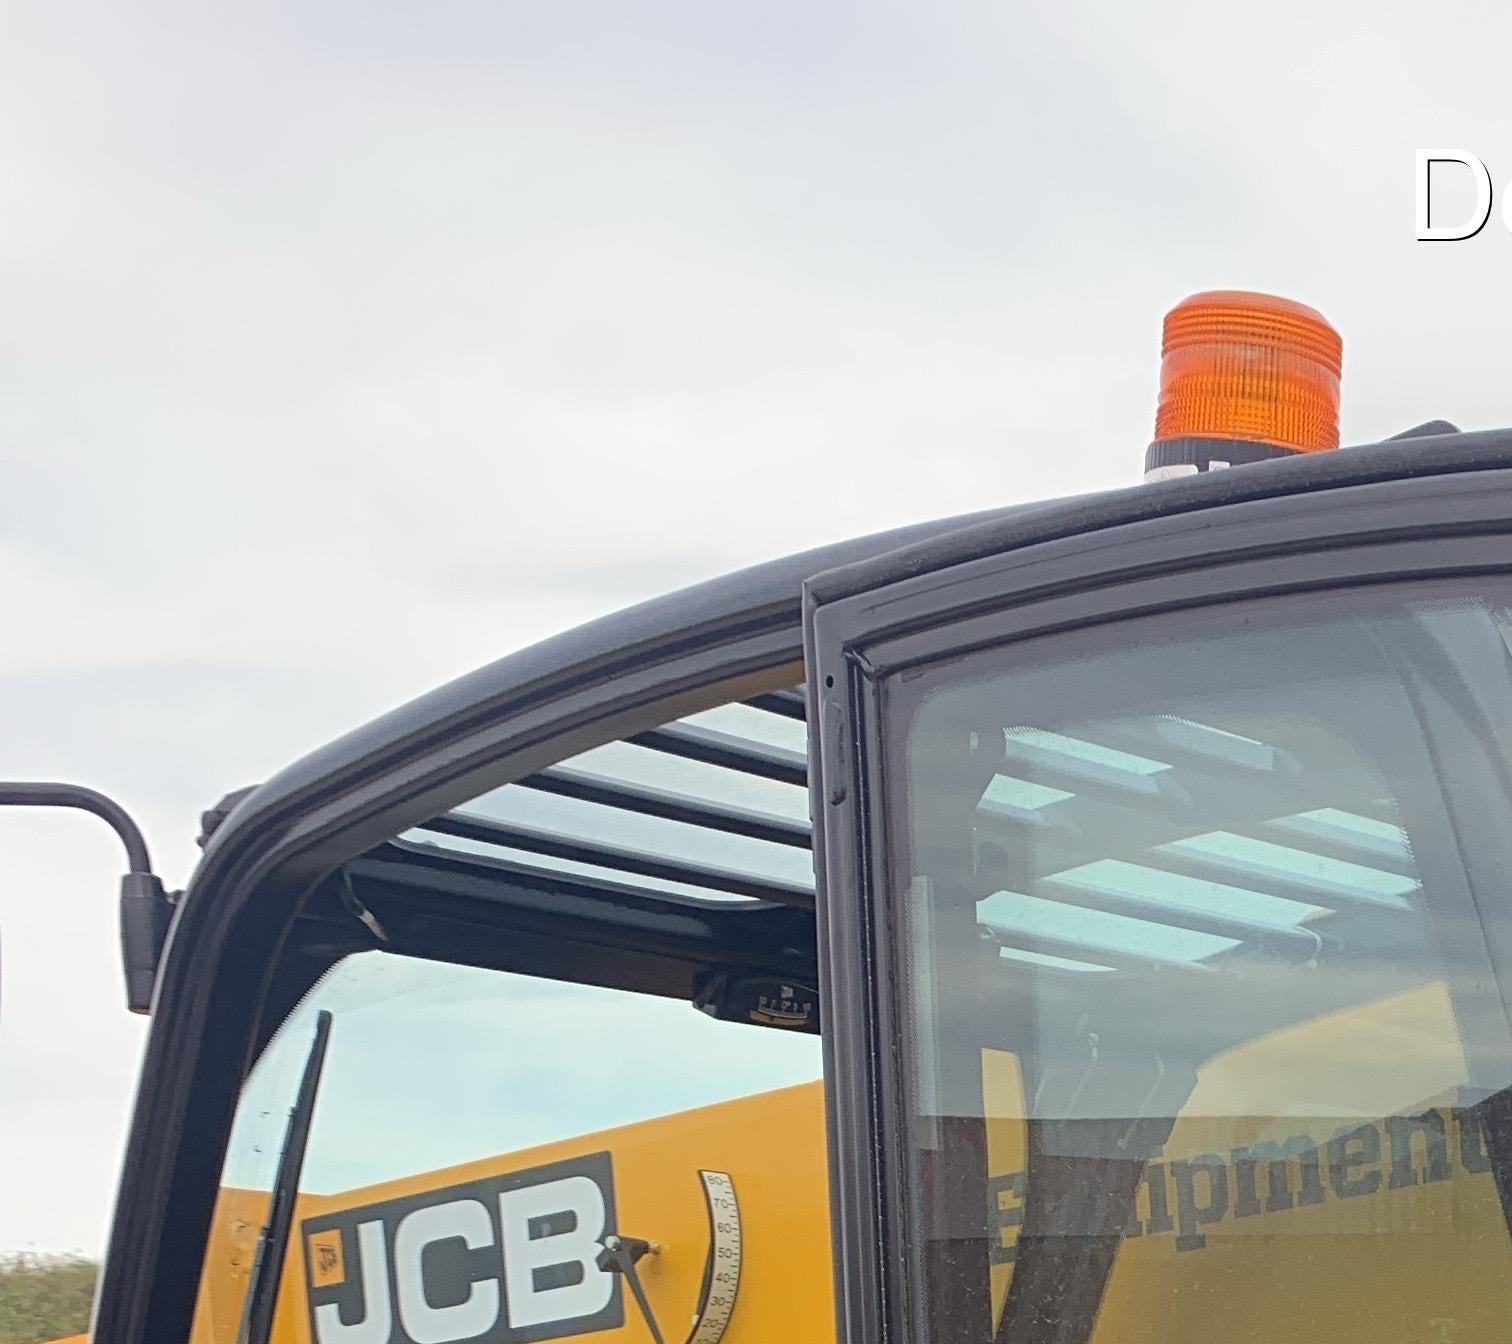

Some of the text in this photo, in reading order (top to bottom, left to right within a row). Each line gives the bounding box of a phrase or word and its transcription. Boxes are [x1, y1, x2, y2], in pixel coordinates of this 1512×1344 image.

[713, 1197, 729, 1209] 70
[717, 1221, 733, 1234] 60
[718, 1247, 733, 1259] 50
[715, 1272, 731, 1284] 40
[710, 1296, 726, 1307] 30
[702, 1317, 718, 1329] 20
